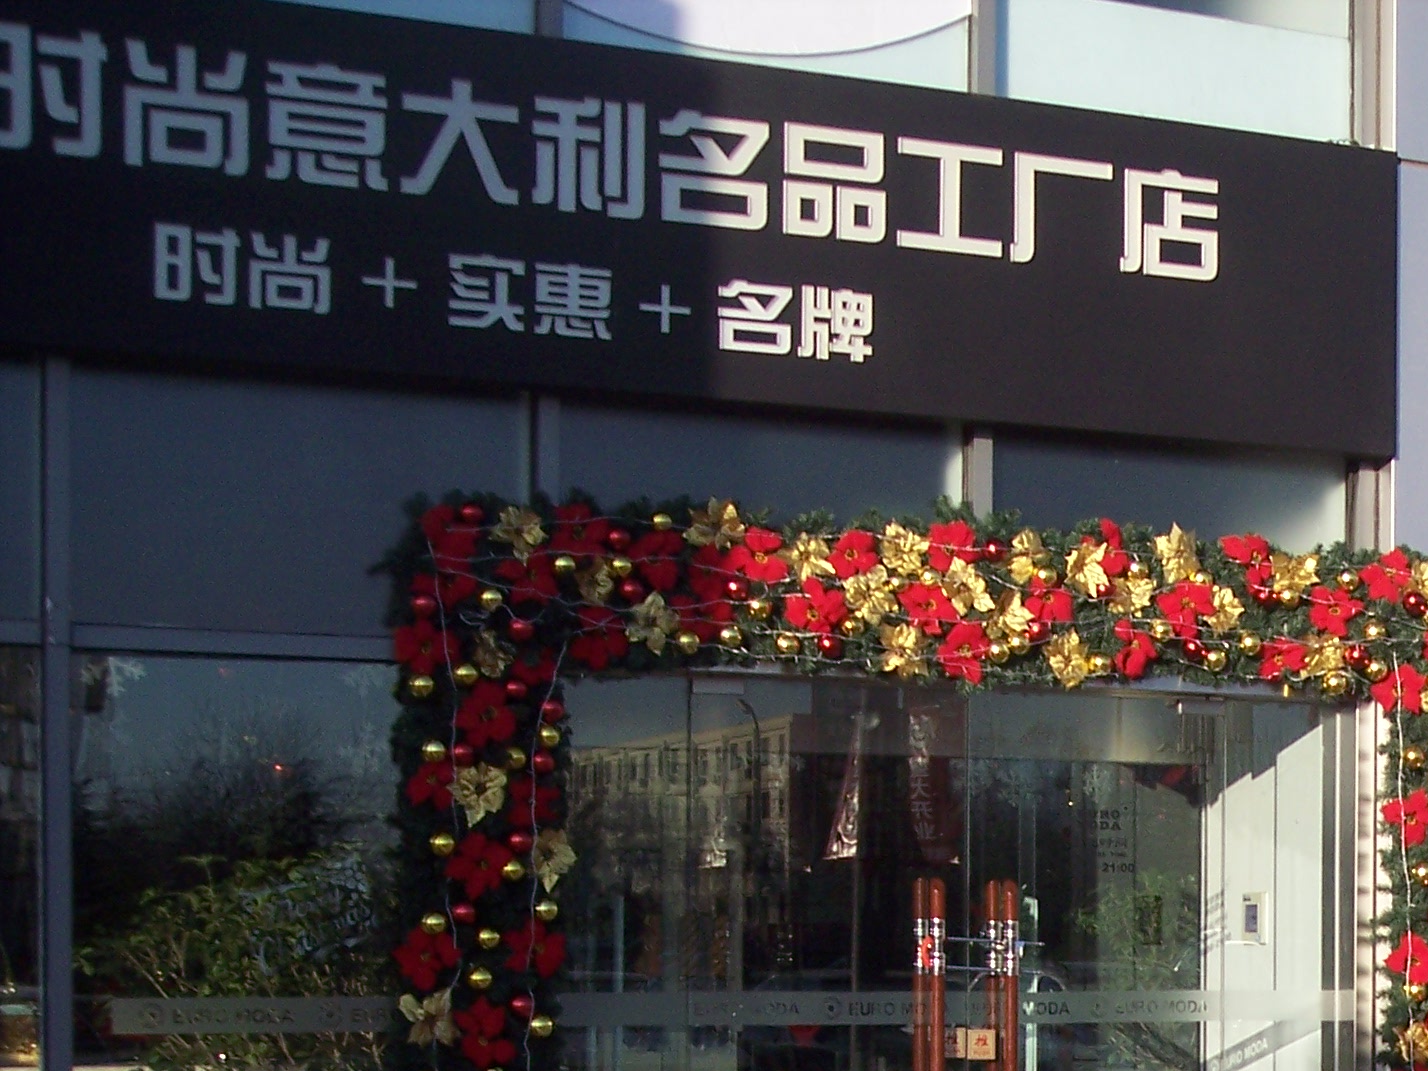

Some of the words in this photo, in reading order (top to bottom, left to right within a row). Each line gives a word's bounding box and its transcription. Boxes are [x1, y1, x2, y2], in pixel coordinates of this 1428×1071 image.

[0, 22, 1219, 281] 时尚意大利名品工厂店
[153, 223, 331, 315] 时尚
[448, 254, 612, 341] 实惠
[718, 279, 874, 363] 名牌
